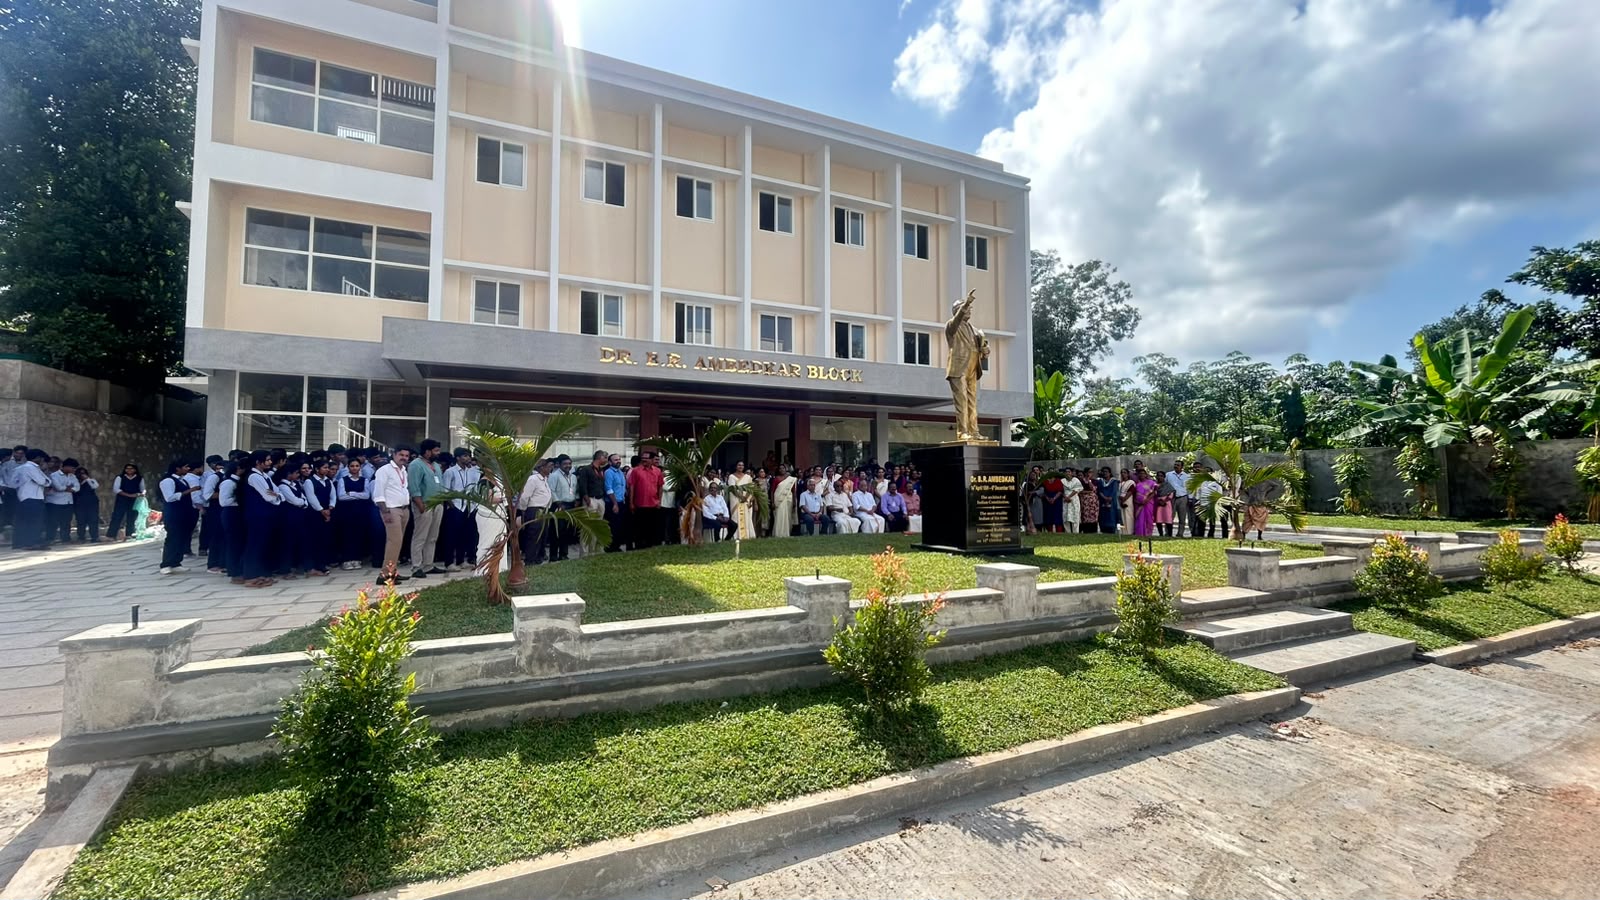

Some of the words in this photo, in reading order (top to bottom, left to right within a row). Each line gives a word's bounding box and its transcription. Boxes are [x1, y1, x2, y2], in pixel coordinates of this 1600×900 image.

[600, 346, 638, 365] DR.
[693, 356, 801, 377] AMBEDKAR
[806, 365, 864, 383] BLOCK
